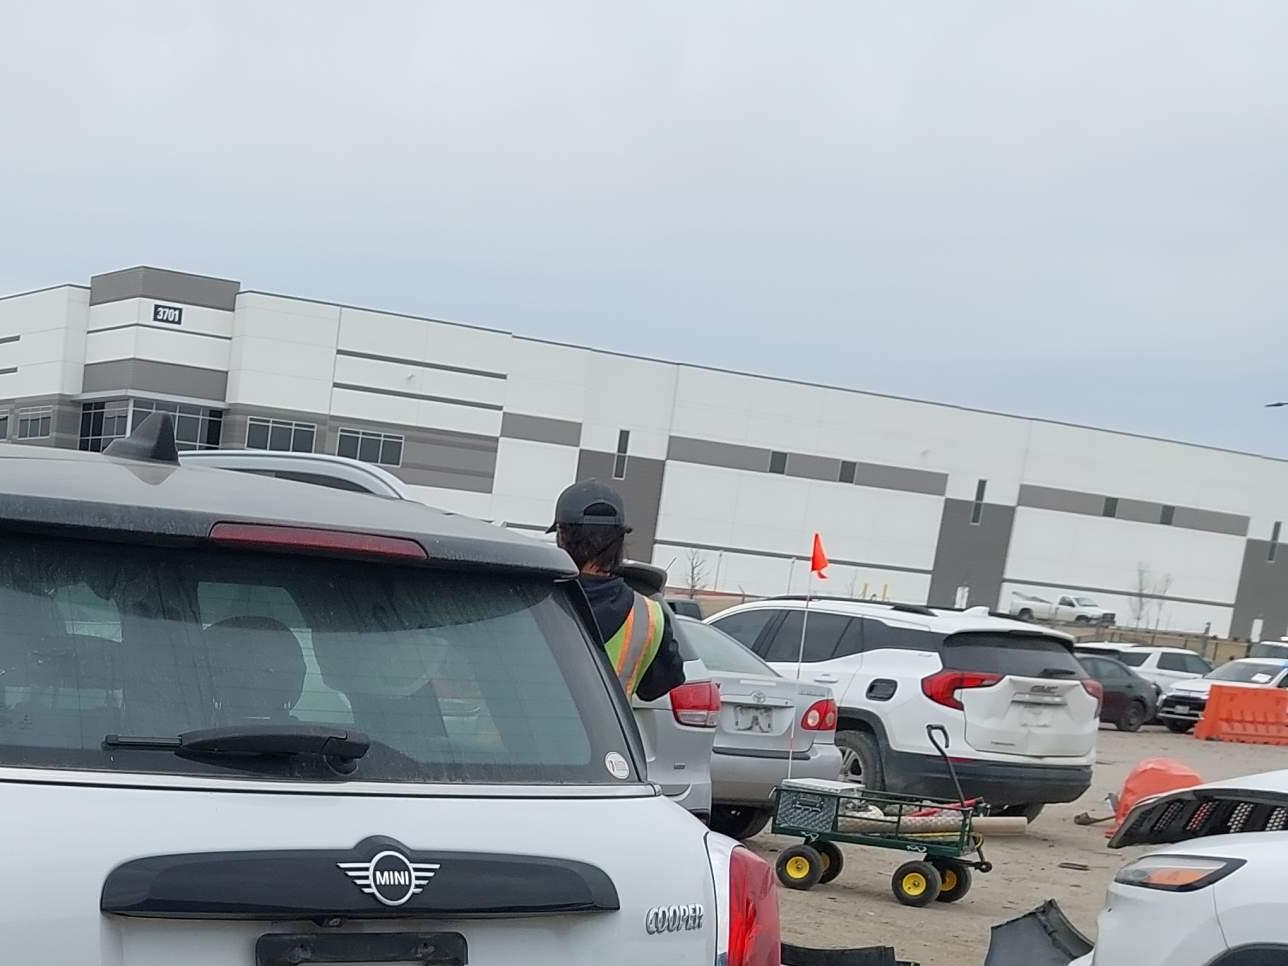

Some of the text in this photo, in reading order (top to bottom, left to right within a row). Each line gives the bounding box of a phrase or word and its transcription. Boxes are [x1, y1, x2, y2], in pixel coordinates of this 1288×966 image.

[156, 307, 180, 322] 3701
[375, 870, 410, 886] MINI
[645, 903, 704, 936] COOPER
